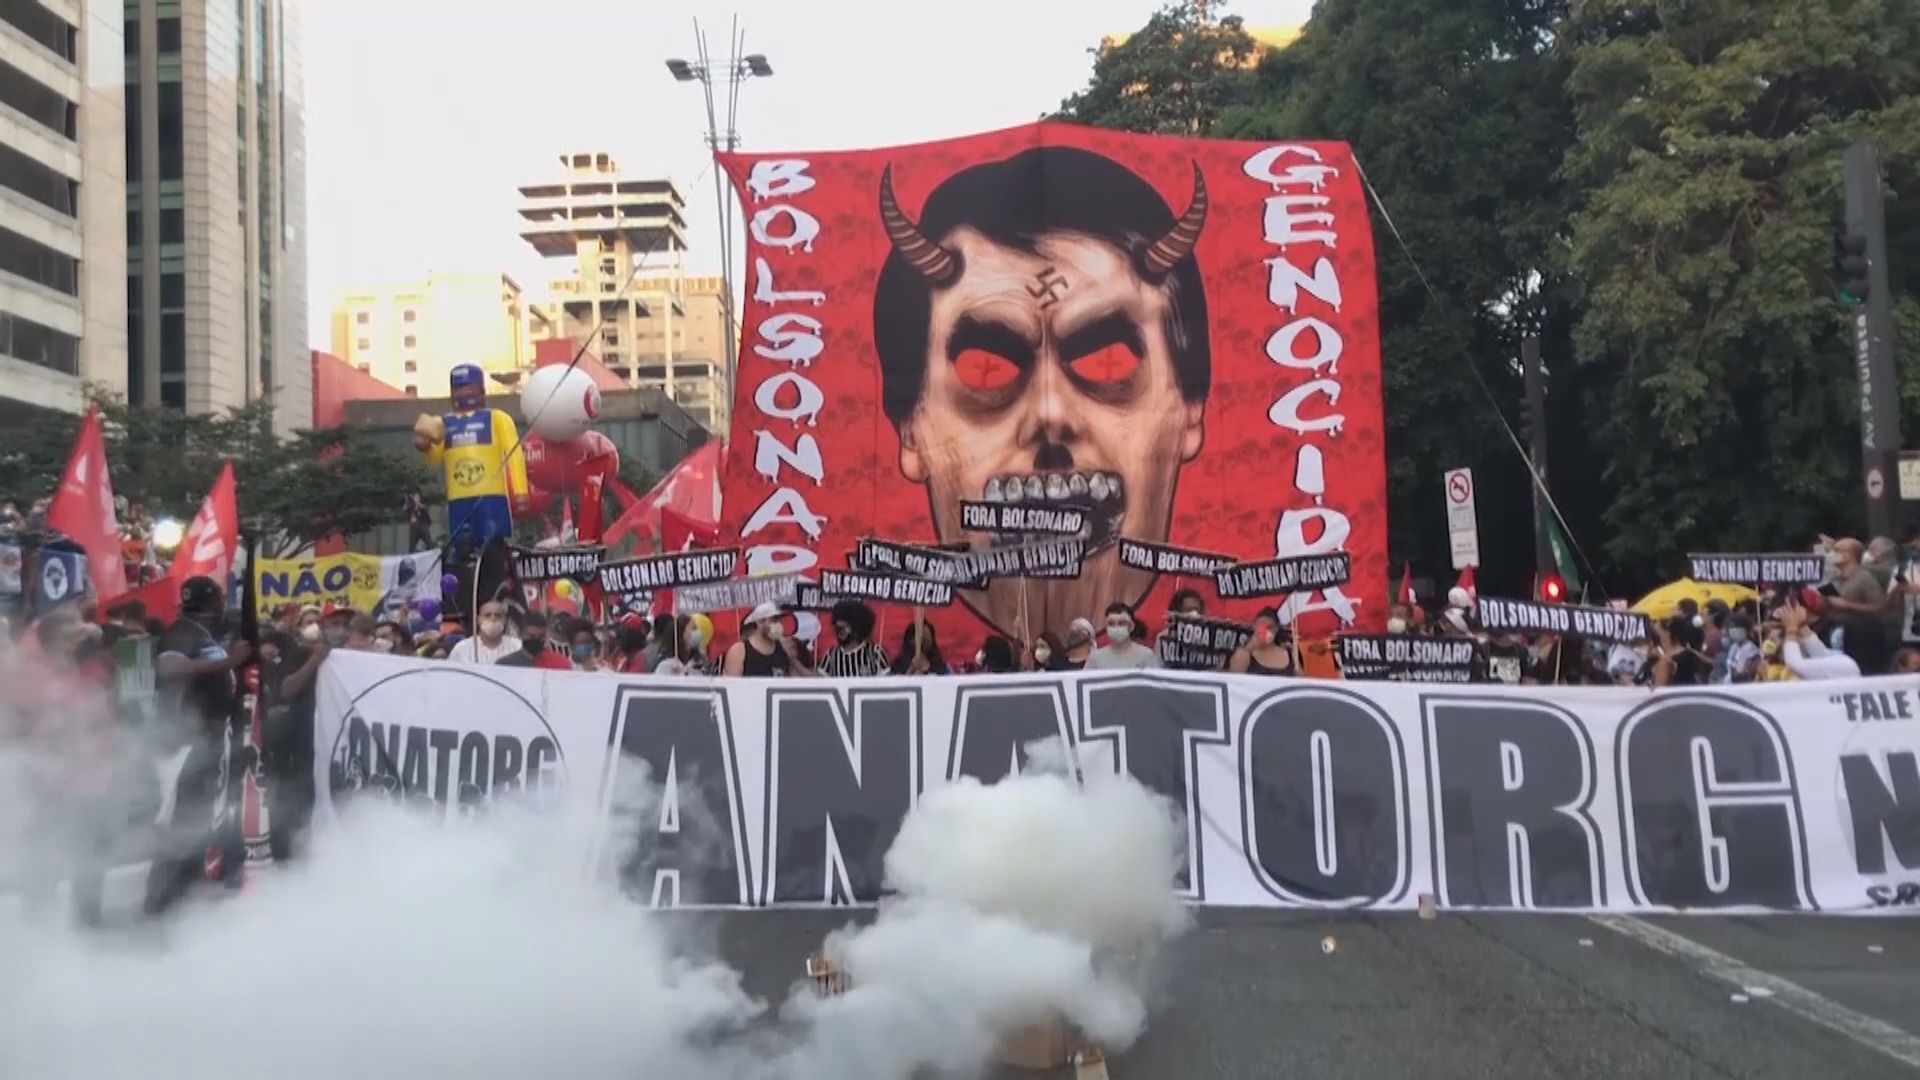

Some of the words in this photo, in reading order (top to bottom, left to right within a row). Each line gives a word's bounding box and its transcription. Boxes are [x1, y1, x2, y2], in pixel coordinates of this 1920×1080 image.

[1856, 314, 1872, 411] Paulista
[963, 506, 996, 527] FORA
[1002, 508, 1082, 531] BOLSONARO
[1122, 544, 1153, 568] FORA
[1692, 559, 1759, 581] BOLSONARO
[1762, 559, 1821, 581] GENOCIDA
[261, 563, 351, 597] NÃO
[601, 560, 675, 591] BOLSONARO
[823, 571, 891, 599] BOLSONARO
[894, 579, 951, 604] GENOCIDA
[1177, 622, 1210, 647] FORA
[1480, 600, 1569, 631] BOLSONARO
[1574, 610, 1646, 641] GENOCIDA
[1344, 638, 1382, 660] FORA
[1386, 639, 1473, 664] BOLSONARO
